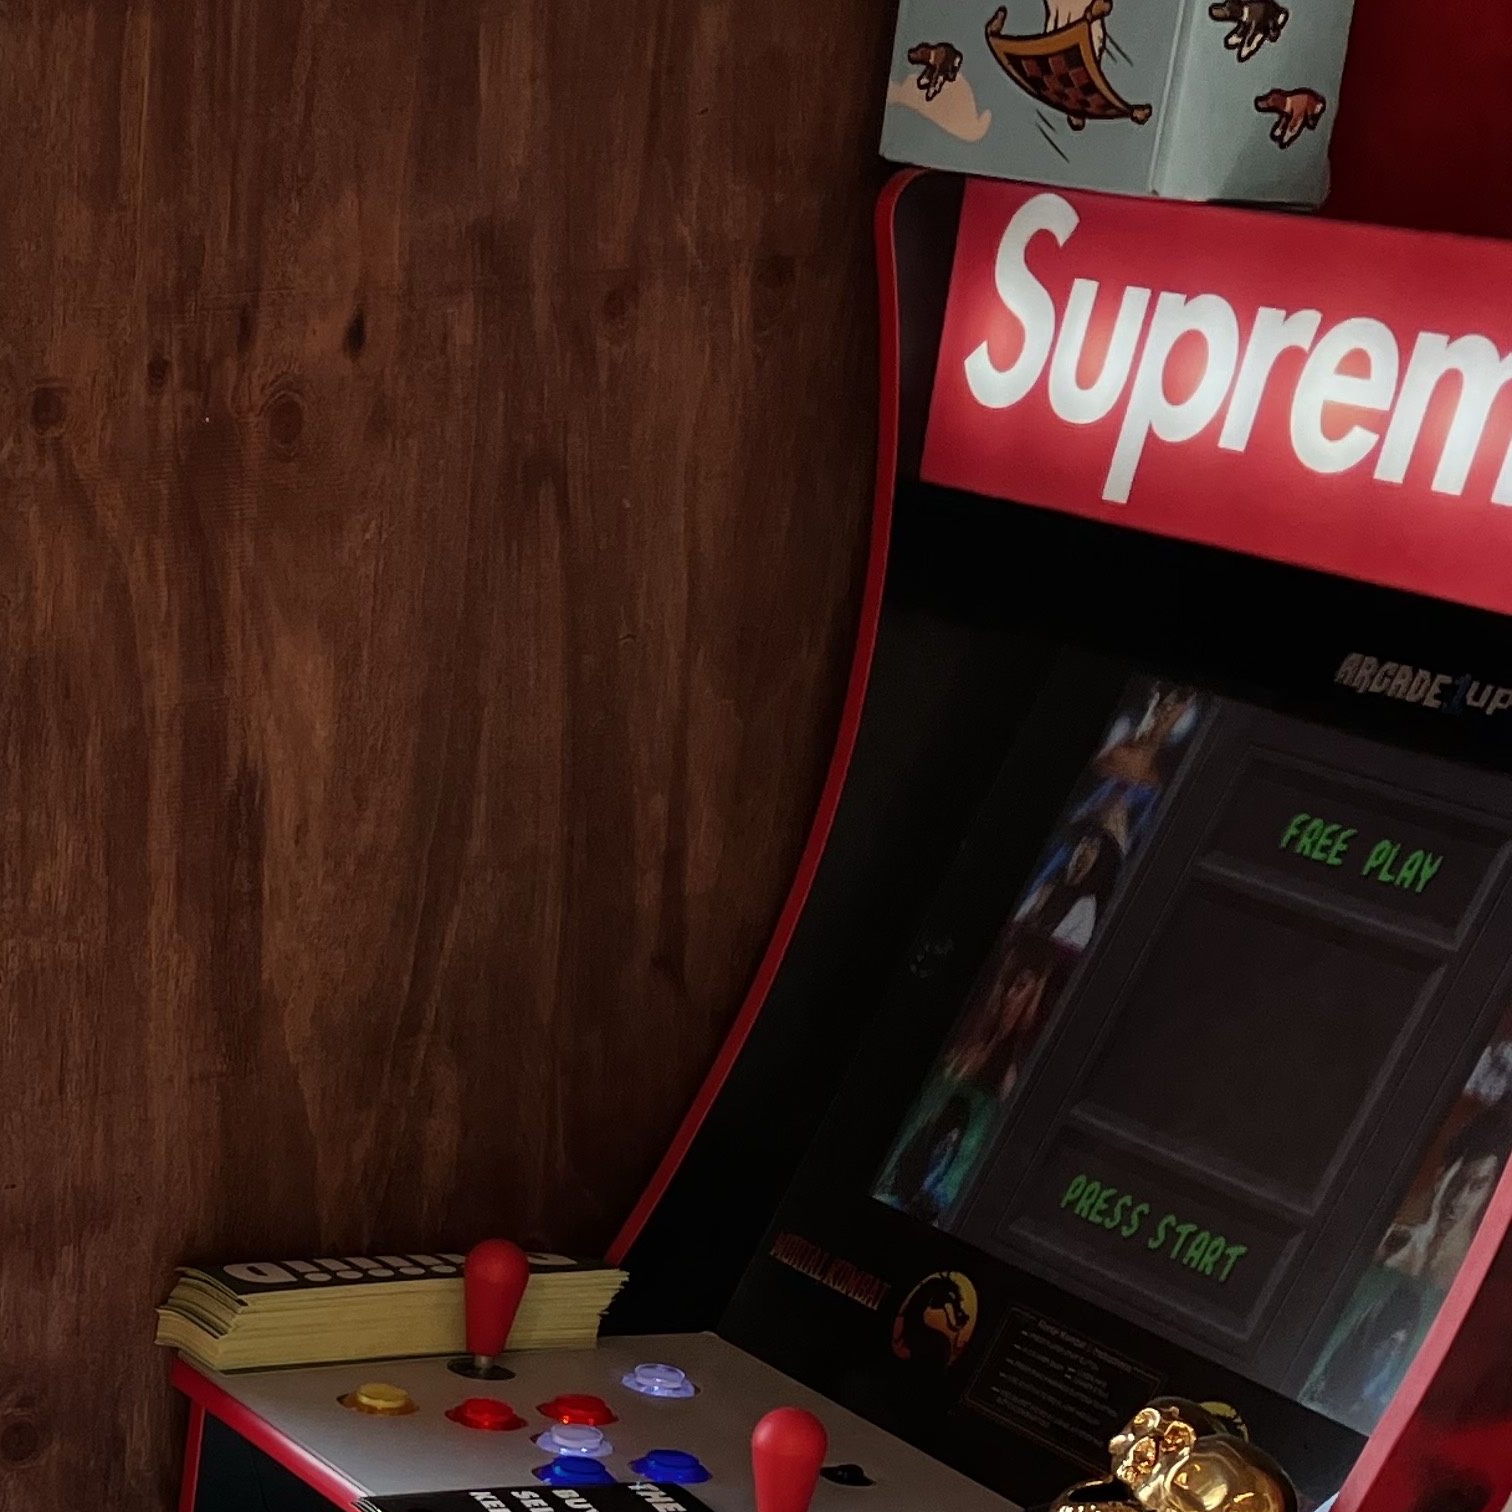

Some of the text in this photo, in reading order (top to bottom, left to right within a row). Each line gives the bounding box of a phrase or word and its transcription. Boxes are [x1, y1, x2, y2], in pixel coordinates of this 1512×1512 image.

[1278, 812, 1444, 894] FREE PLAY
[1060, 1174, 1248, 1283] PRESS START
